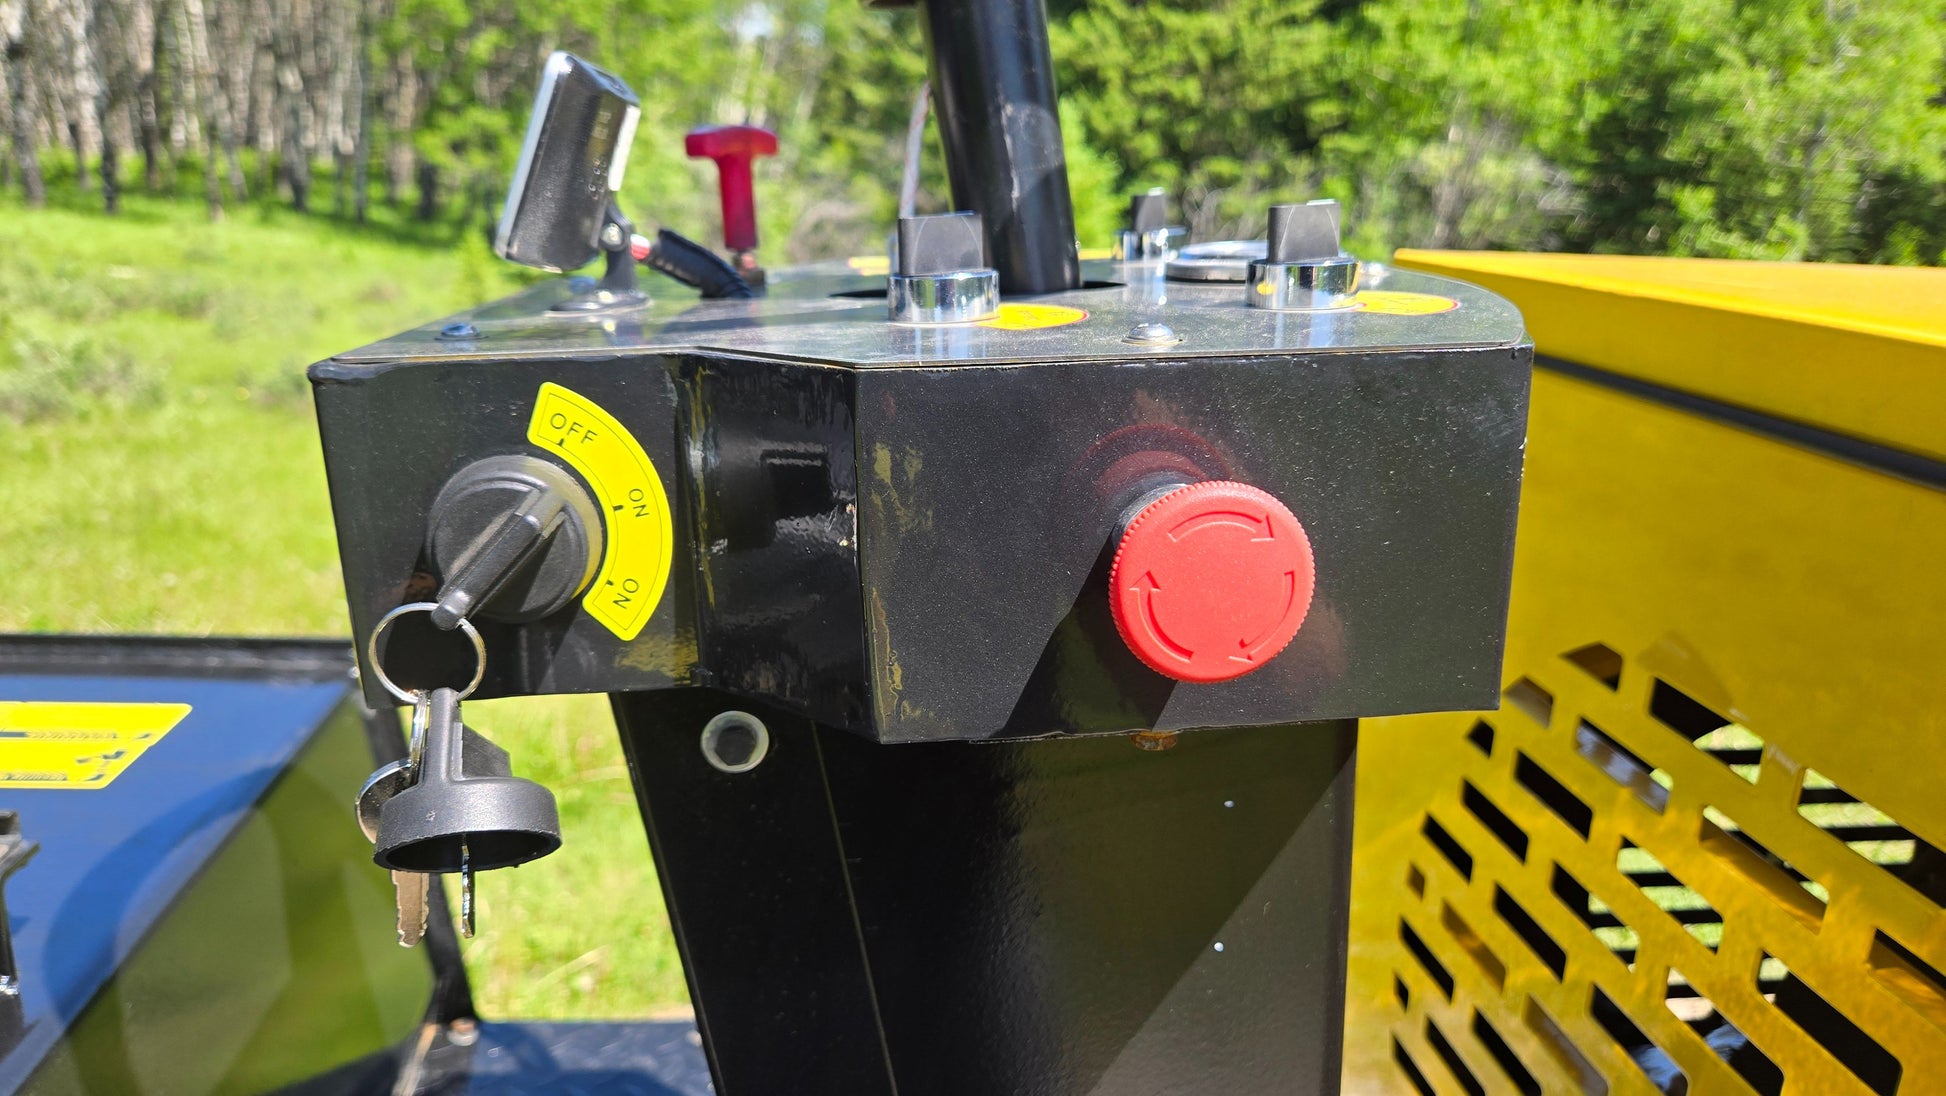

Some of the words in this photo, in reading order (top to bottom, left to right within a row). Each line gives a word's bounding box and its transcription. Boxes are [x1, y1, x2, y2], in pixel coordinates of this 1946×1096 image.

[550, 412, 598, 445] OFF
[628, 488, 650, 518] ON
[612, 578, 640, 610] ON
